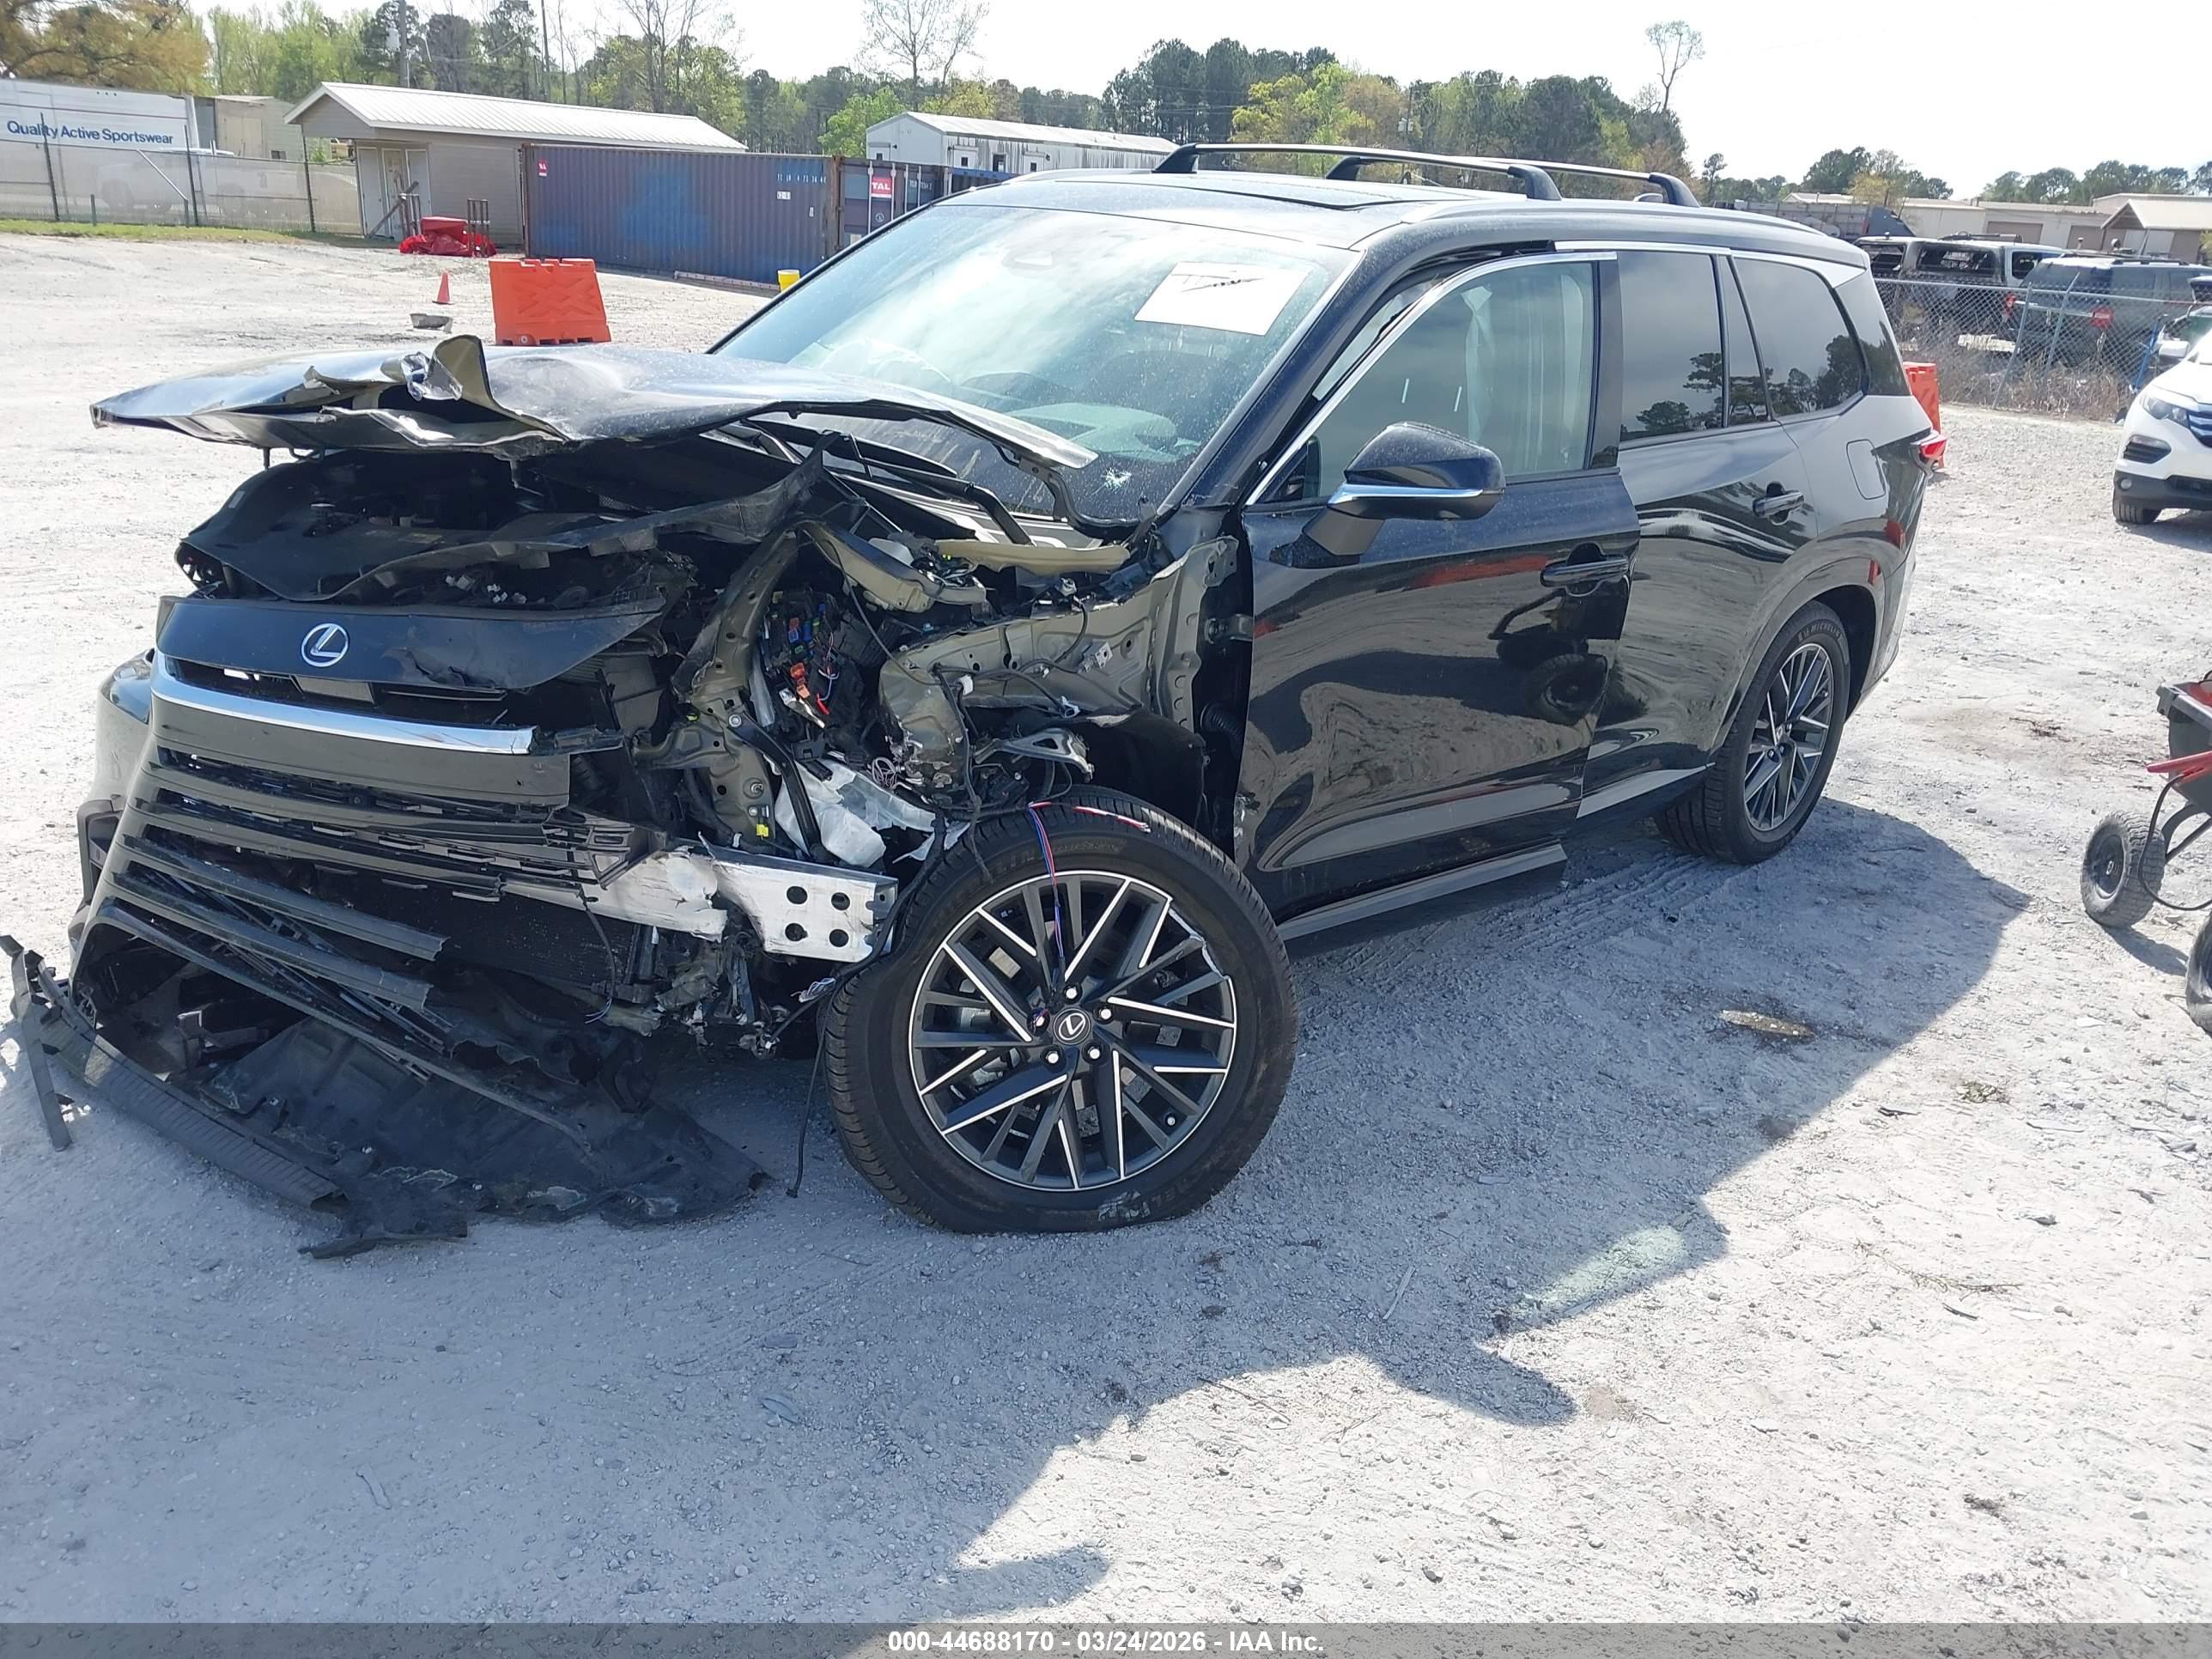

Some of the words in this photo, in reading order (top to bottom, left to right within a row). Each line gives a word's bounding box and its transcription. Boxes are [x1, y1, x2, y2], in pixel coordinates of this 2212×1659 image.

[61, 125, 100, 140] Active
[102, 128, 173, 144] Sportswear
[872, 181, 891, 191] TAL
